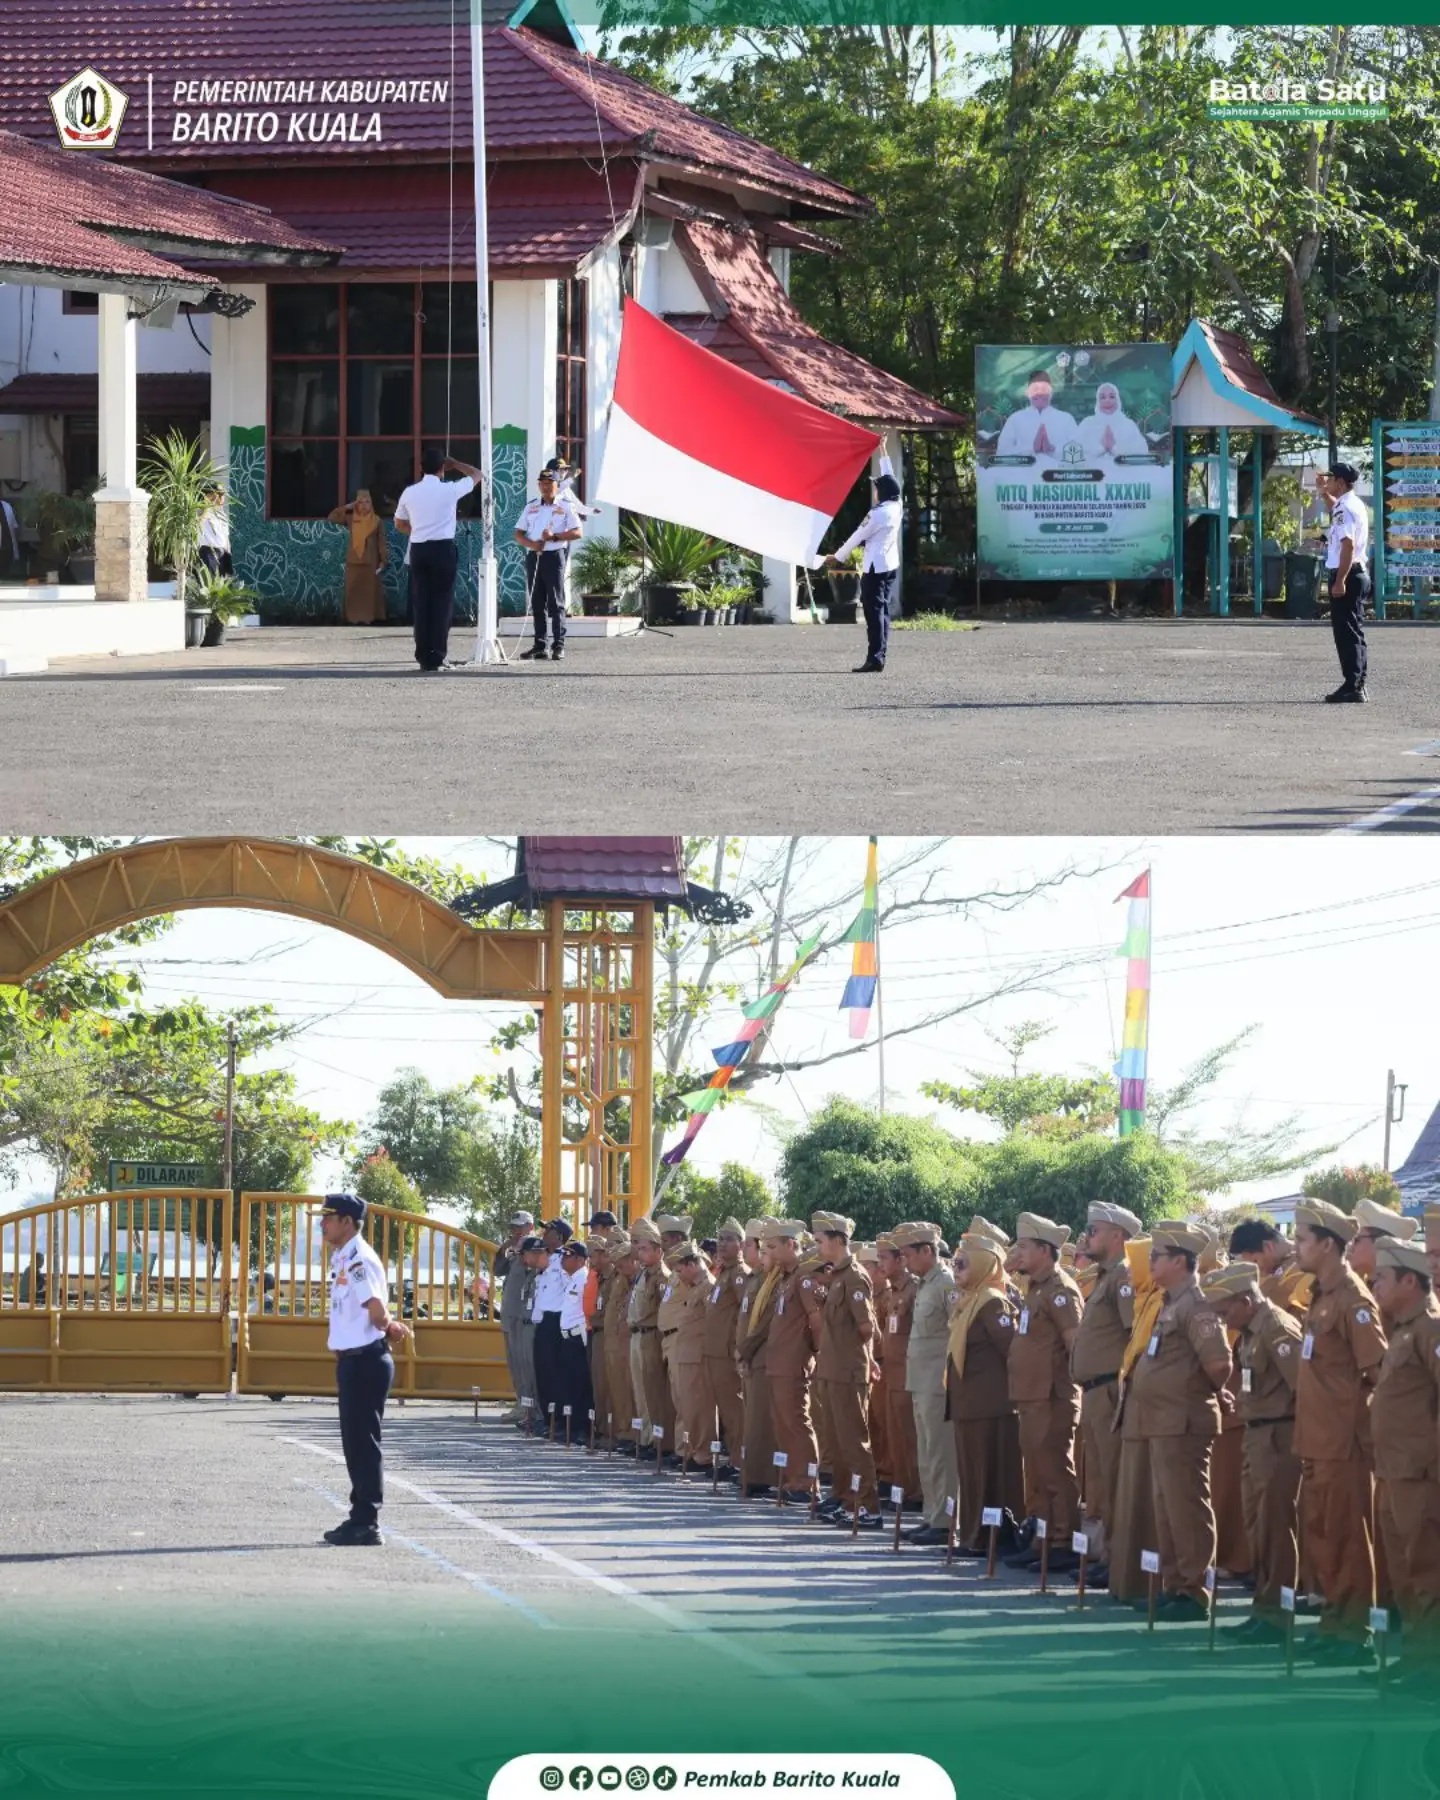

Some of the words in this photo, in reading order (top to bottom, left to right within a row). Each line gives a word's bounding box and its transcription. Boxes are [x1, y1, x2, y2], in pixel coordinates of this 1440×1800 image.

[996, 484, 1028, 502] MTQ
[1032, 483, 1100, 502] NASIONAL
[1105, 483, 1151, 501] XXXVII
